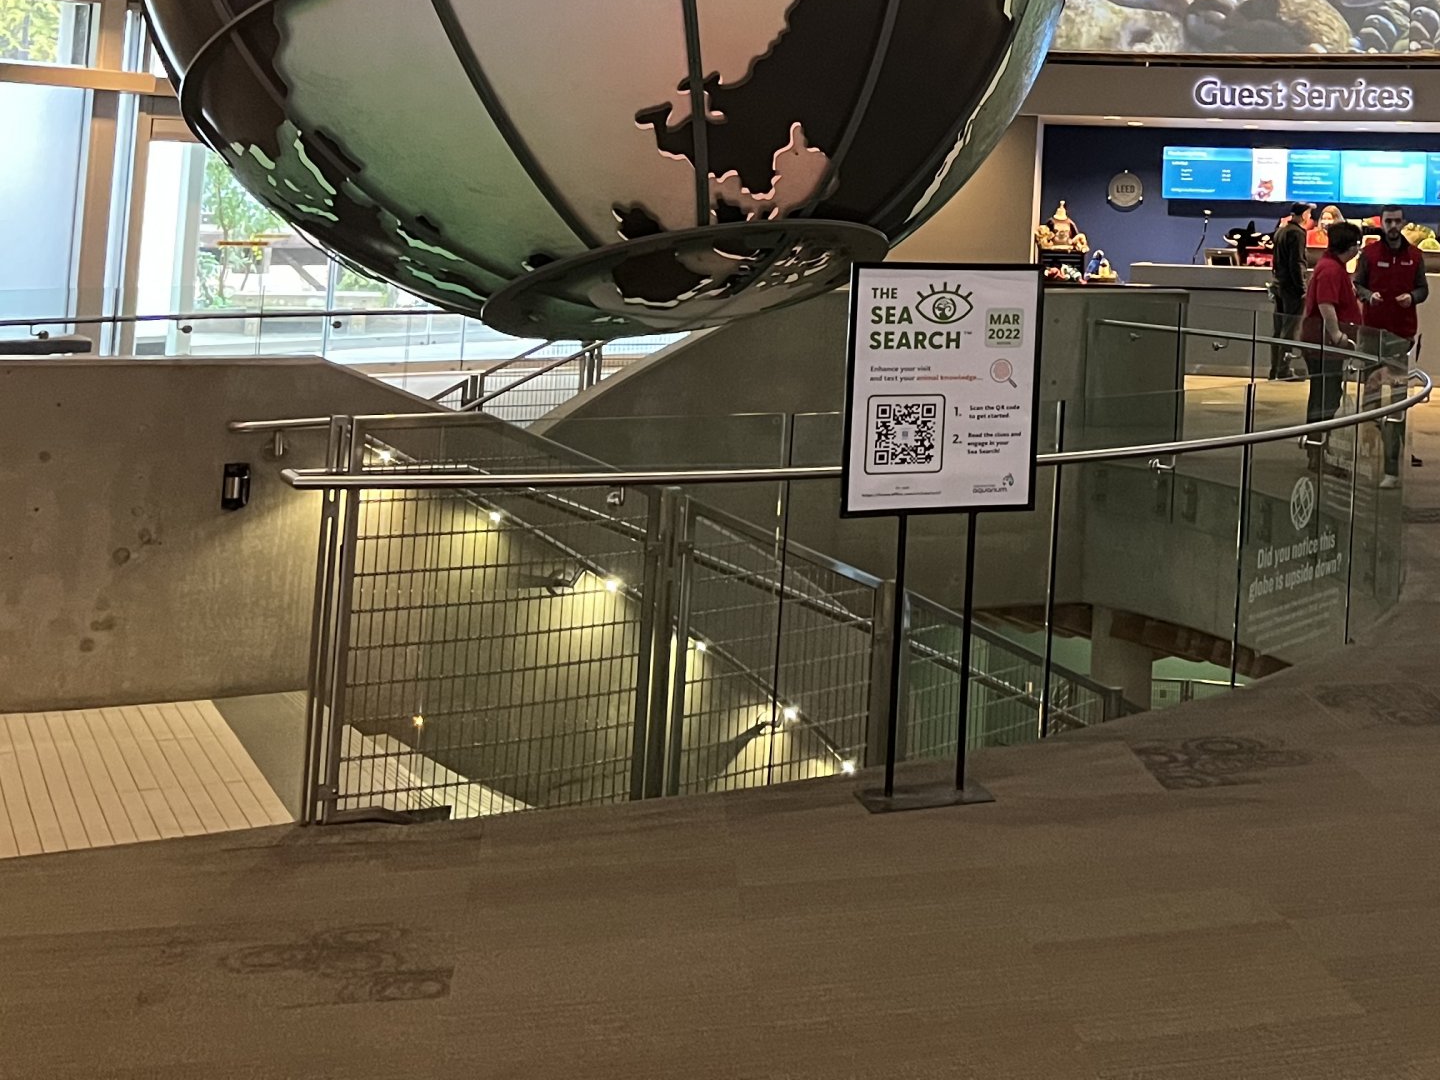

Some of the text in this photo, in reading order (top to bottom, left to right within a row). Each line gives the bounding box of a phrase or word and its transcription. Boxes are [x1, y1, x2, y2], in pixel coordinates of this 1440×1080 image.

[1194, 78, 1411, 110] Guest Services
[1116, 184, 1135, 194] LEED
[872, 287, 898, 300] THE
[870, 306, 913, 325] SEA
[989, 313, 1020, 325] MAR
[869, 331, 961, 350] SEARCH
[988, 328, 1020, 340] 2022
[900, 375, 915, 383] your
[953, 406, 962, 417] 1.
[995, 404, 1005, 412] QR
[952, 433, 963, 444] 2.
[972, 487, 1008, 495] aquarium
[1257, 531, 1336, 569] Did you notice this
[1248, 552, 1342, 604] globe is upside down?
